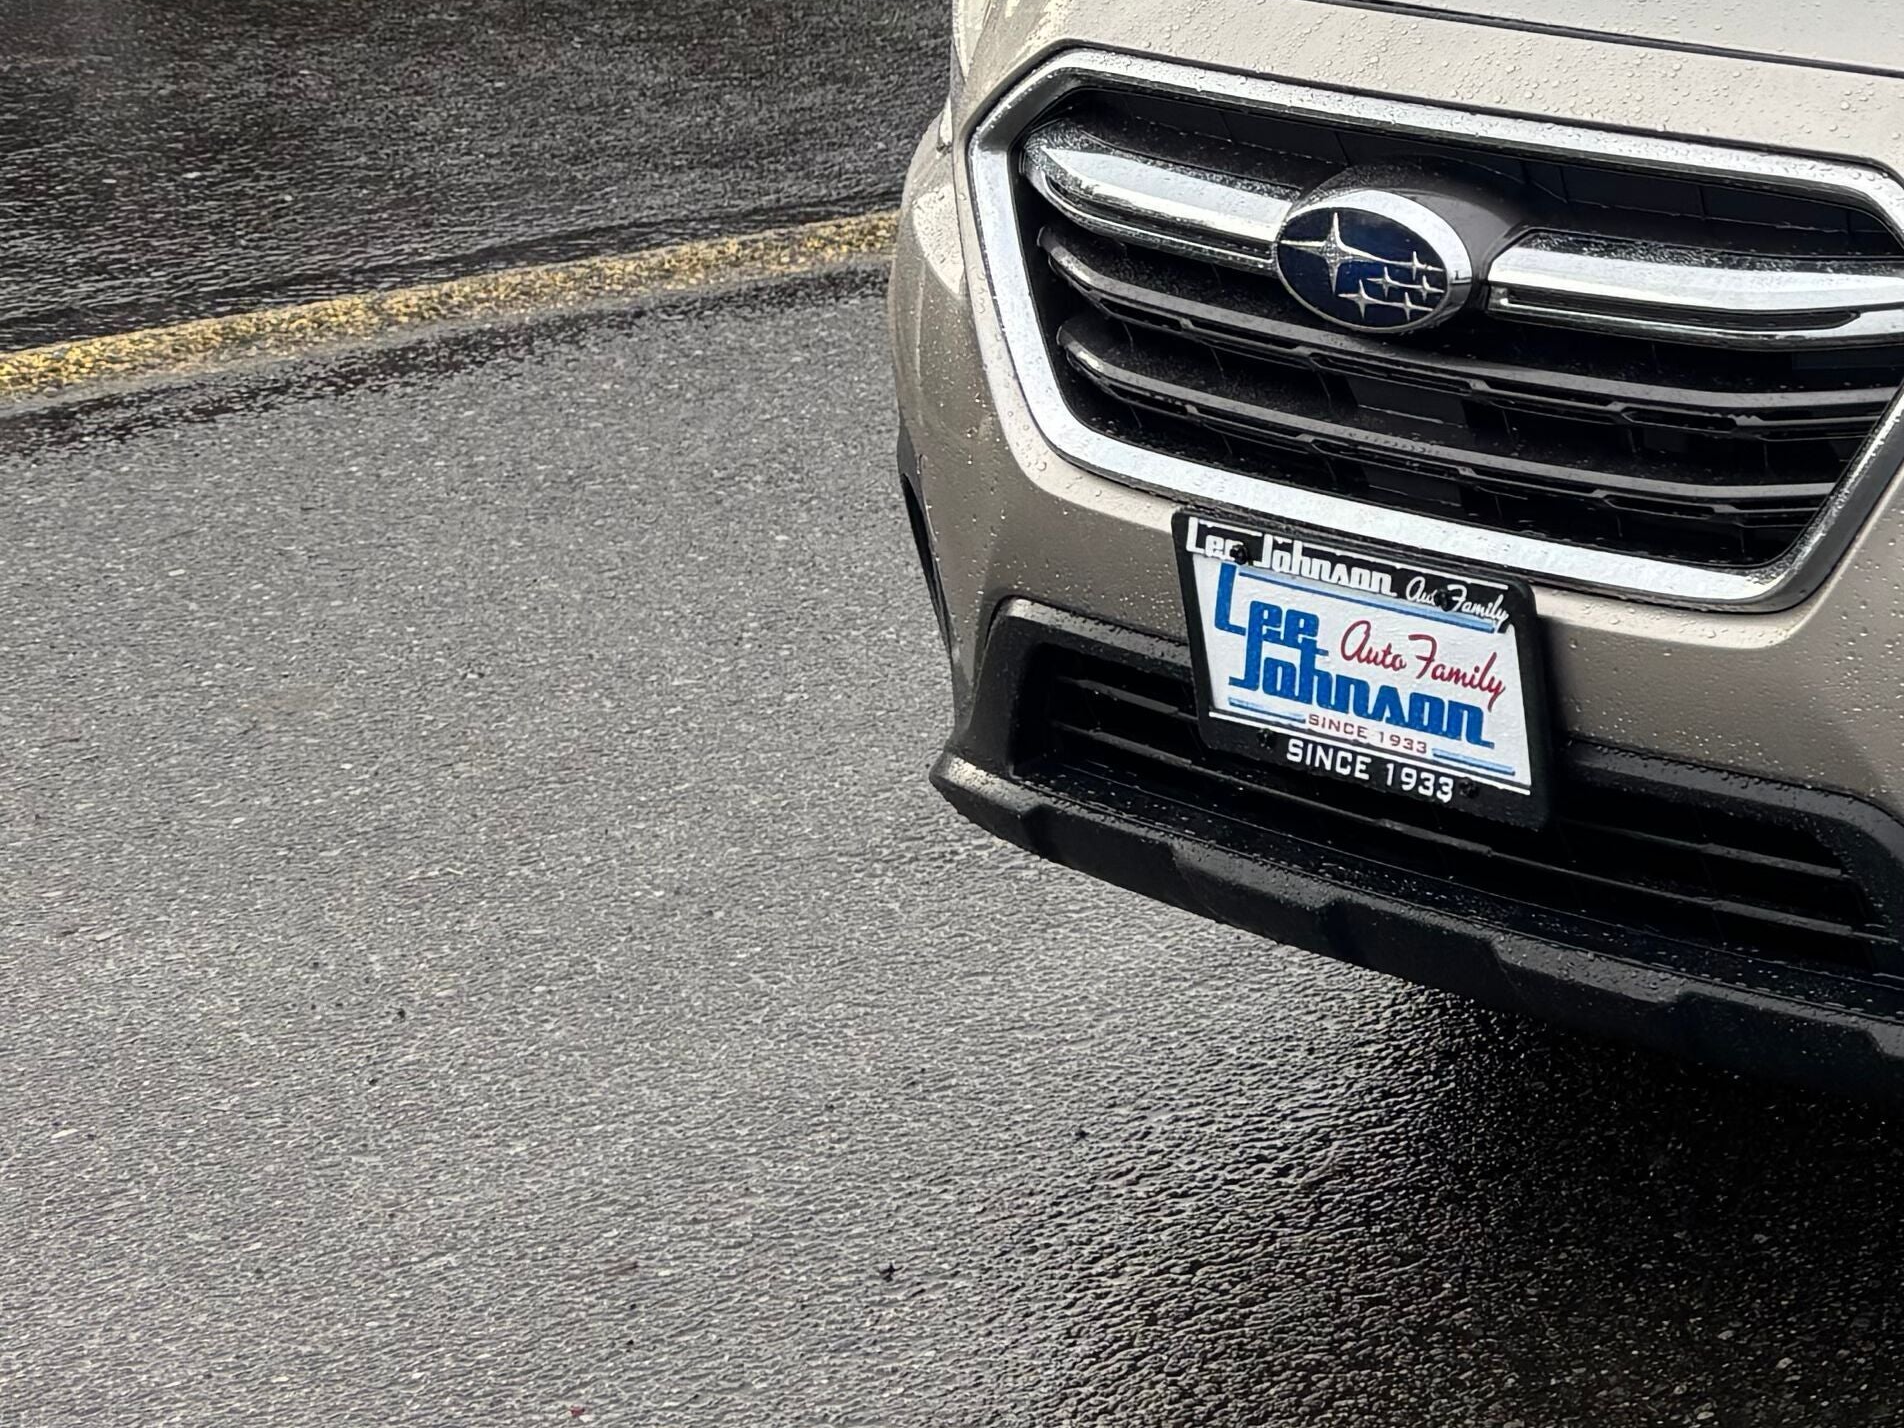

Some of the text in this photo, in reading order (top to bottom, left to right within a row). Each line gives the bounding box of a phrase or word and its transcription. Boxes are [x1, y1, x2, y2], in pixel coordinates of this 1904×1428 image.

[1214, 562, 1329, 655] Lee
[1252, 534, 1398, 597] Johnson
[1447, 584, 1510, 633] Family
[1229, 620, 1494, 749] Johnson
[1341, 620, 1506, 712] Auto Family
[1286, 738, 1454, 803] SINCE 1933
[1309, 713, 1427, 755] SINCE 1933
